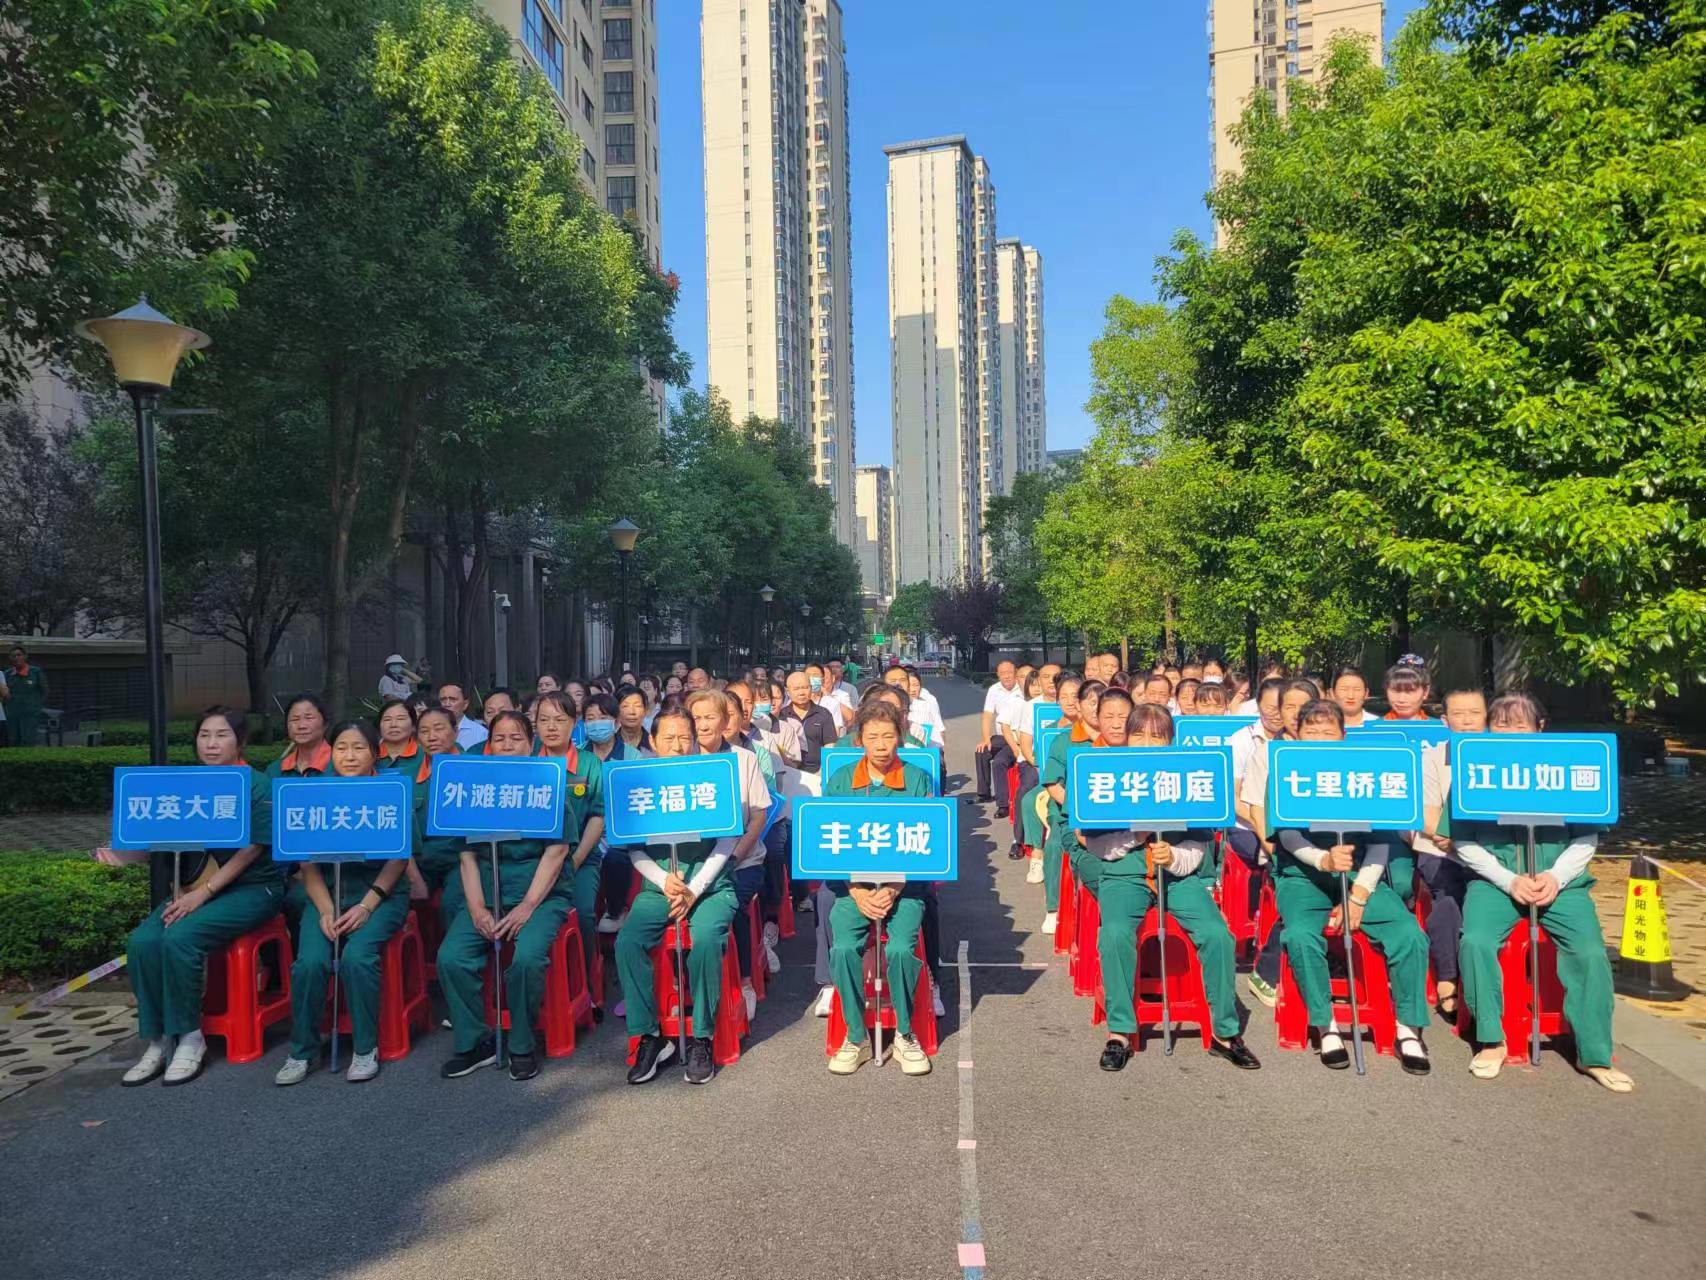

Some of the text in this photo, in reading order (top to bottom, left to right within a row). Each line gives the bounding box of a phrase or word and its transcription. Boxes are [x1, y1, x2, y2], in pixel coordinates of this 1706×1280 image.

[1087, 770, 1216, 803] 君华御庭
[1283, 769, 1409, 801] 七里桥堡
[1467, 761, 1602, 792] 江山如画
[127, 793, 238, 823] 双英大厦
[442, 782, 553, 811] 外滩新城
[628, 782, 718, 816] 幸福湾
[286, 804, 399, 831] 区机关大院
[819, 821, 932, 856] 丰华城
[1634, 899, 1647, 957] 阳光物业
